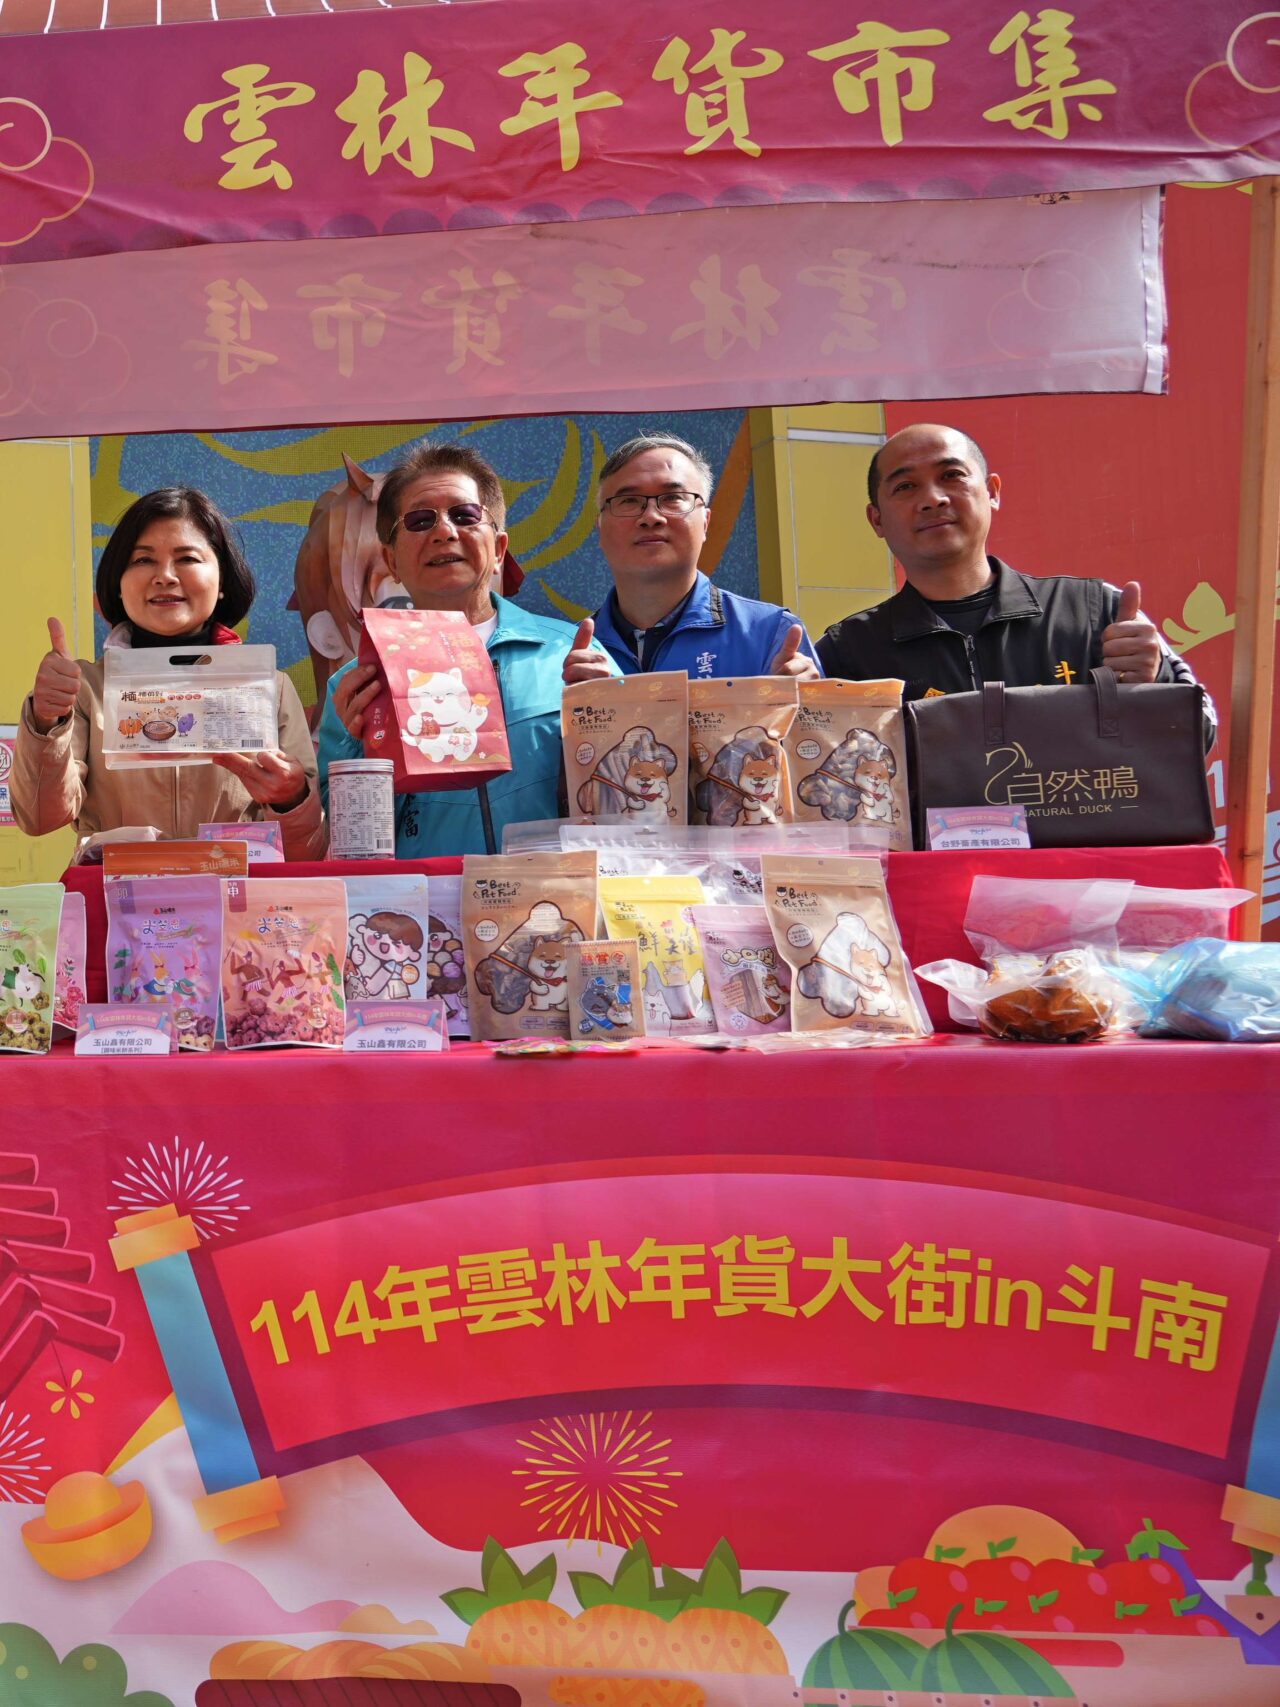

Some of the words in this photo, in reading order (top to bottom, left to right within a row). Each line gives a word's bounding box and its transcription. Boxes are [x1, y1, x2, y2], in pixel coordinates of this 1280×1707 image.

[183, 9, 1117, 191] 雲林年貨市集
[696, 651, 717, 680] 雲
[586, 706, 607, 716] Best
[1007, 765, 1139, 806] 自然鴨
[1078, 804, 1113, 815] DUCK
[490, 880, 512, 889] Best
[227, 886, 239, 897] 申
[481, 889, 496, 899] Pet
[498, 887, 517, 898] Food
[789, 887, 809, 899] Best
[356, 1039, 427, 1049] 玉山鑫有限公司
[248, 1233, 1228, 1374] 114年雲林年貨大街in斗南
